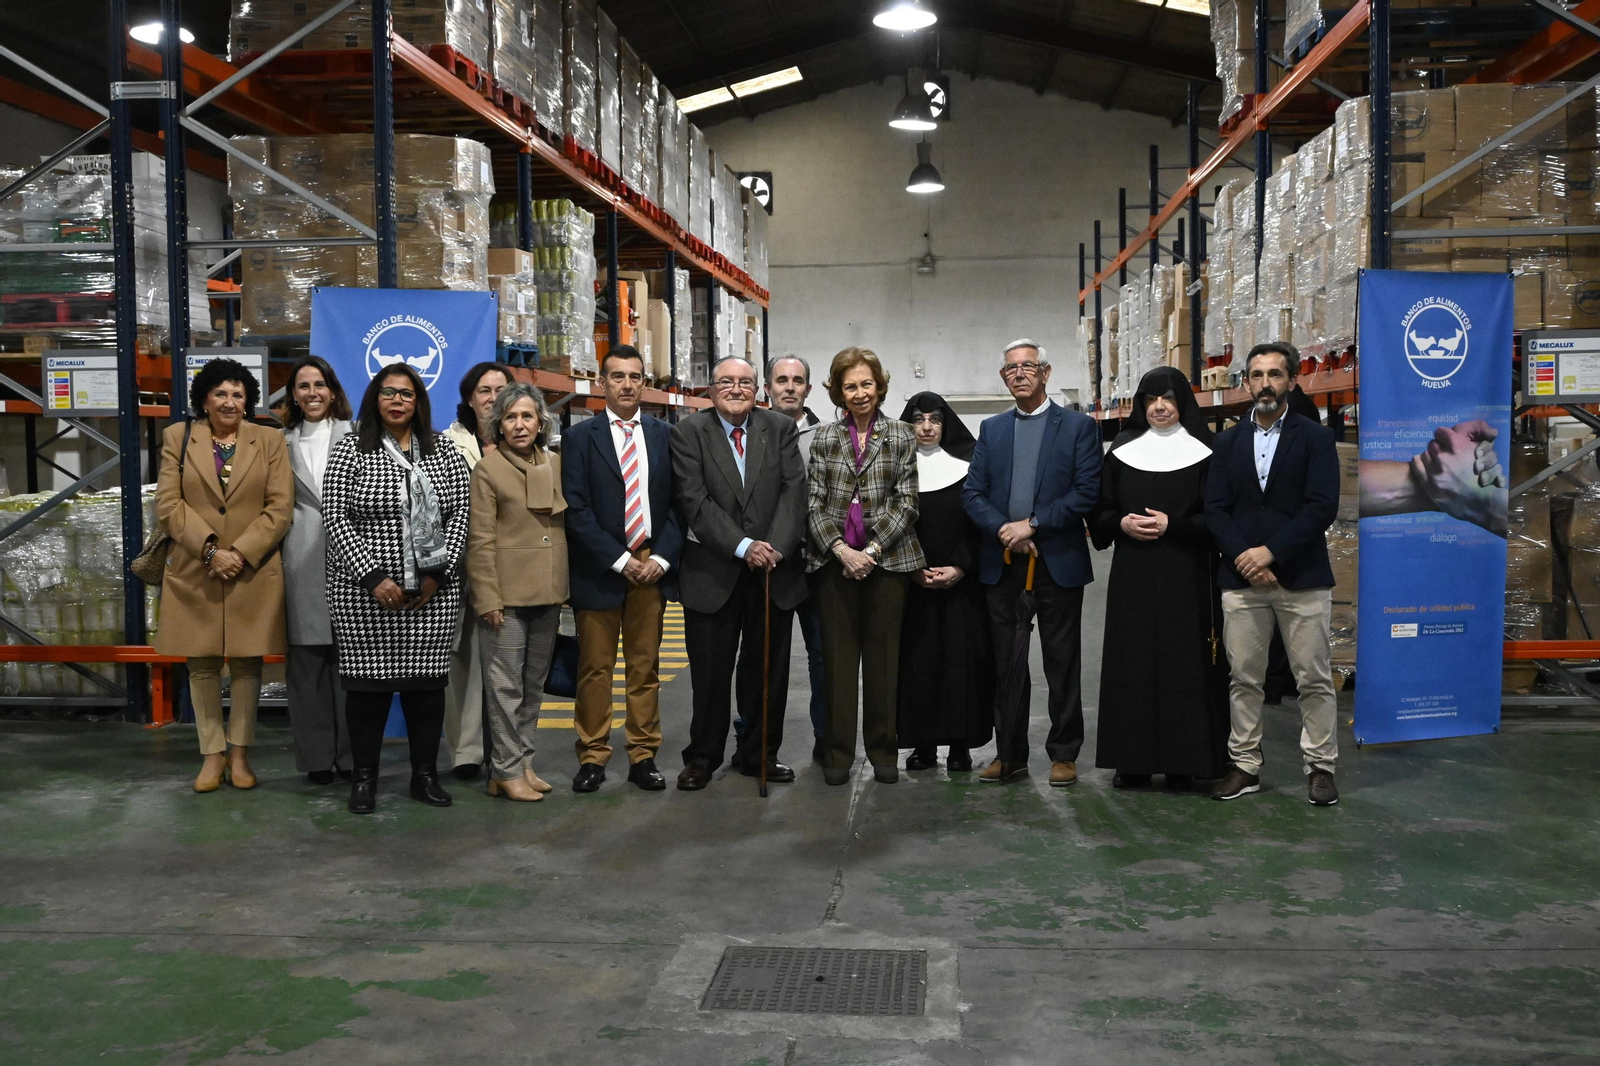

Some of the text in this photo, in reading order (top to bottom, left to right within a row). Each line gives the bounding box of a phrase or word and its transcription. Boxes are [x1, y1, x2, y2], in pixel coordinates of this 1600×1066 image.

[1400, 296, 1472, 330] BANCO DE ALIMENTOS
[362, 314, 448, 349] BANCO DE ALIMENTOS
[1421, 379, 1451, 389] HUELVA
[1428, 414, 1458, 424] equidad
[1394, 429, 1433, 439] eficiencia
[1363, 440, 1392, 451] justicia
[1430, 533, 1457, 544] diálogo
[1384, 606, 1417, 614] Declarado
[1429, 604, 1452, 612] utilidad
